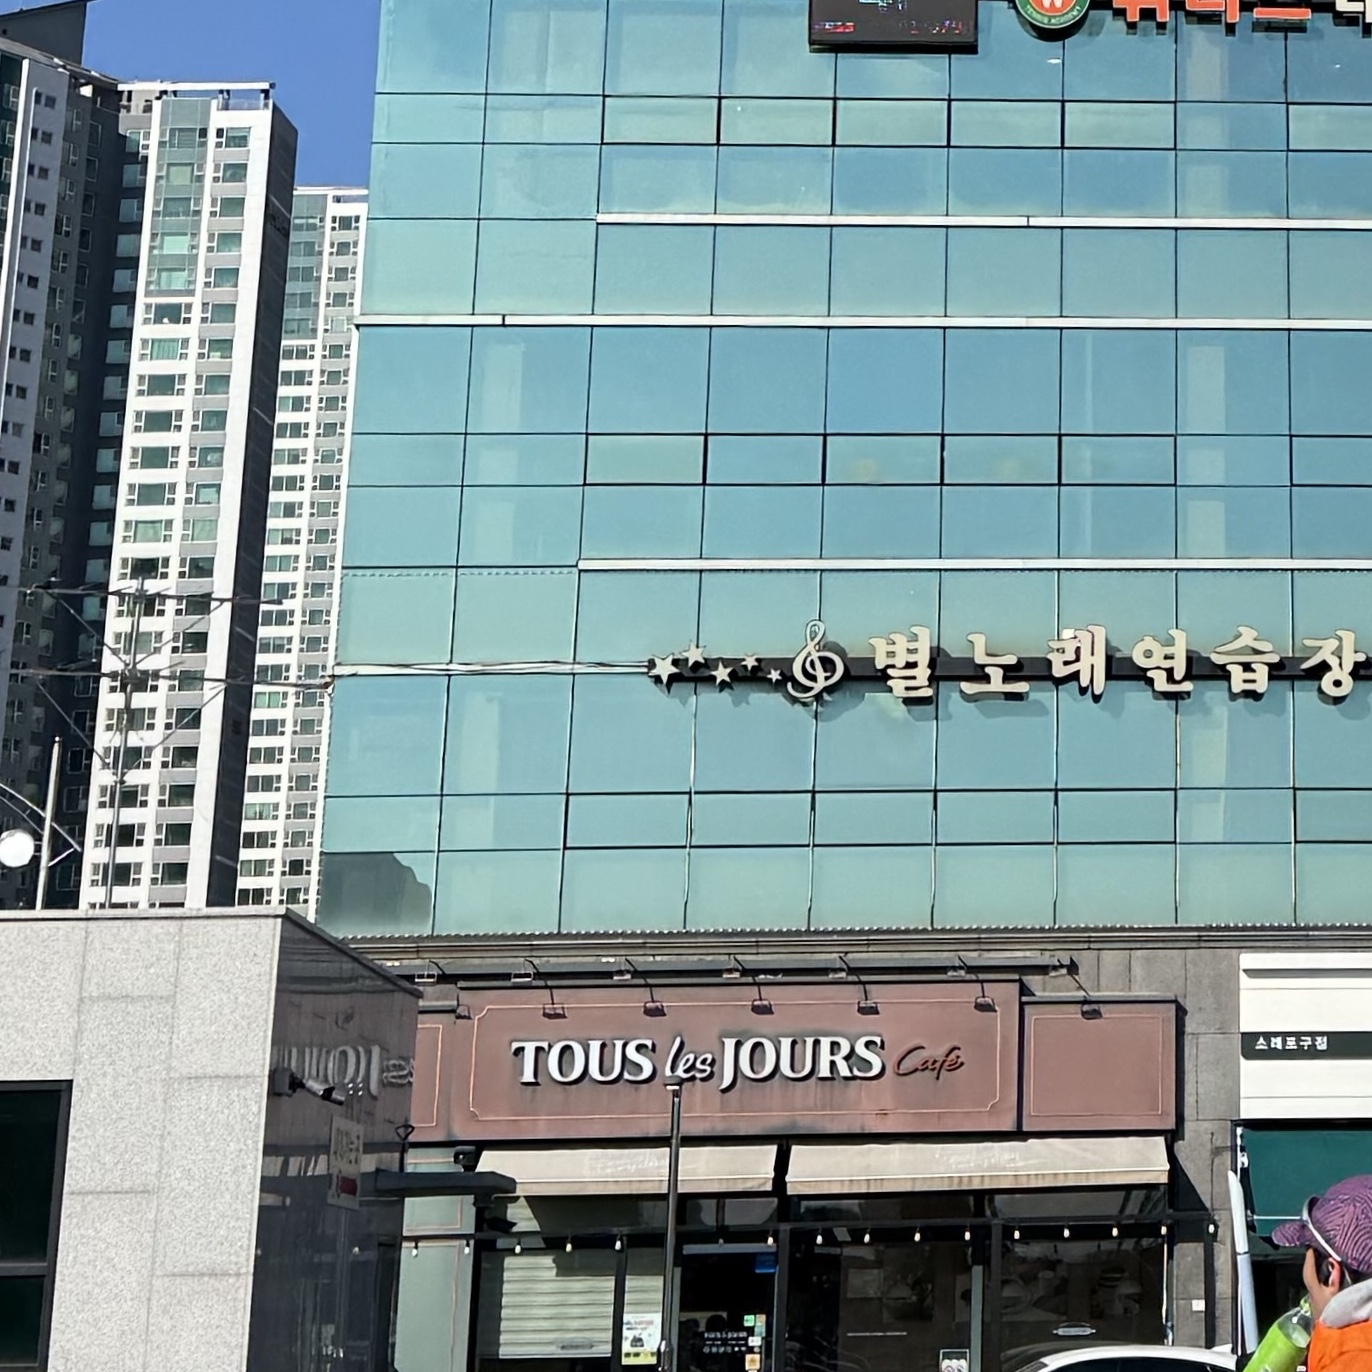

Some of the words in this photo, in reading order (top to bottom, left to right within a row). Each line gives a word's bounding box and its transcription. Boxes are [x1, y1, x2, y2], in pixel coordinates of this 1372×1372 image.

[511, 1038, 655, 1085] TOUS
[664, 1037, 714, 1084] les
[720, 1035, 885, 1092] JOURS
